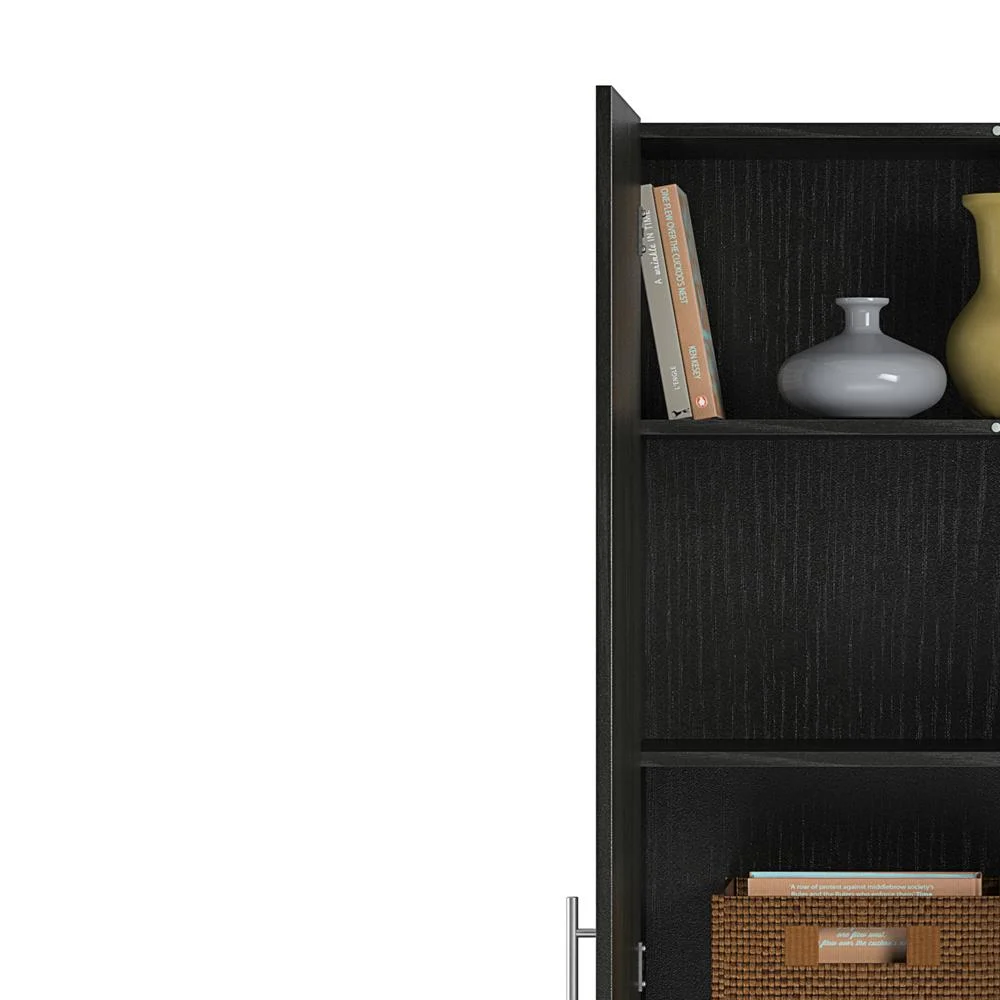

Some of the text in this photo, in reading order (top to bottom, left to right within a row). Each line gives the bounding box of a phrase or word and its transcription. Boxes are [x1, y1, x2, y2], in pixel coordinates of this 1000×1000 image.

[646, 232, 655, 242] IN
[666, 221, 677, 239] OVER
[670, 239, 679, 253] THE
[679, 286, 688, 304] NEST
[688, 345, 697, 359] KEN
